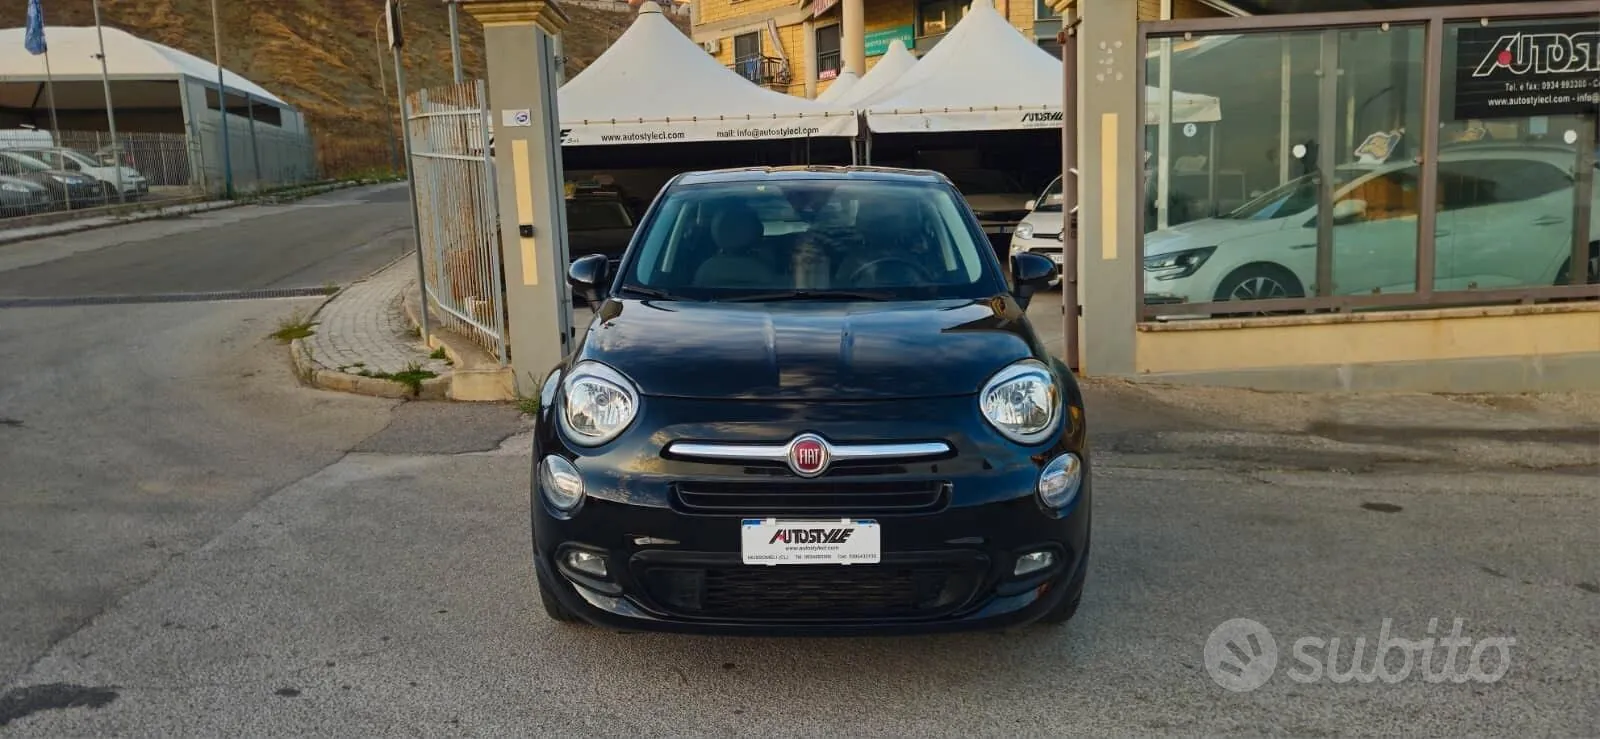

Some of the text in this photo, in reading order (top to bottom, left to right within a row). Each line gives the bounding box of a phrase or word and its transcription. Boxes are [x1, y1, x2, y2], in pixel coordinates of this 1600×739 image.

[601, 131, 685, 142] www.autostylecl.com
[716, 126, 819, 138] mail: info@autostylecl.com
[799, 448, 820, 465] FIAT
